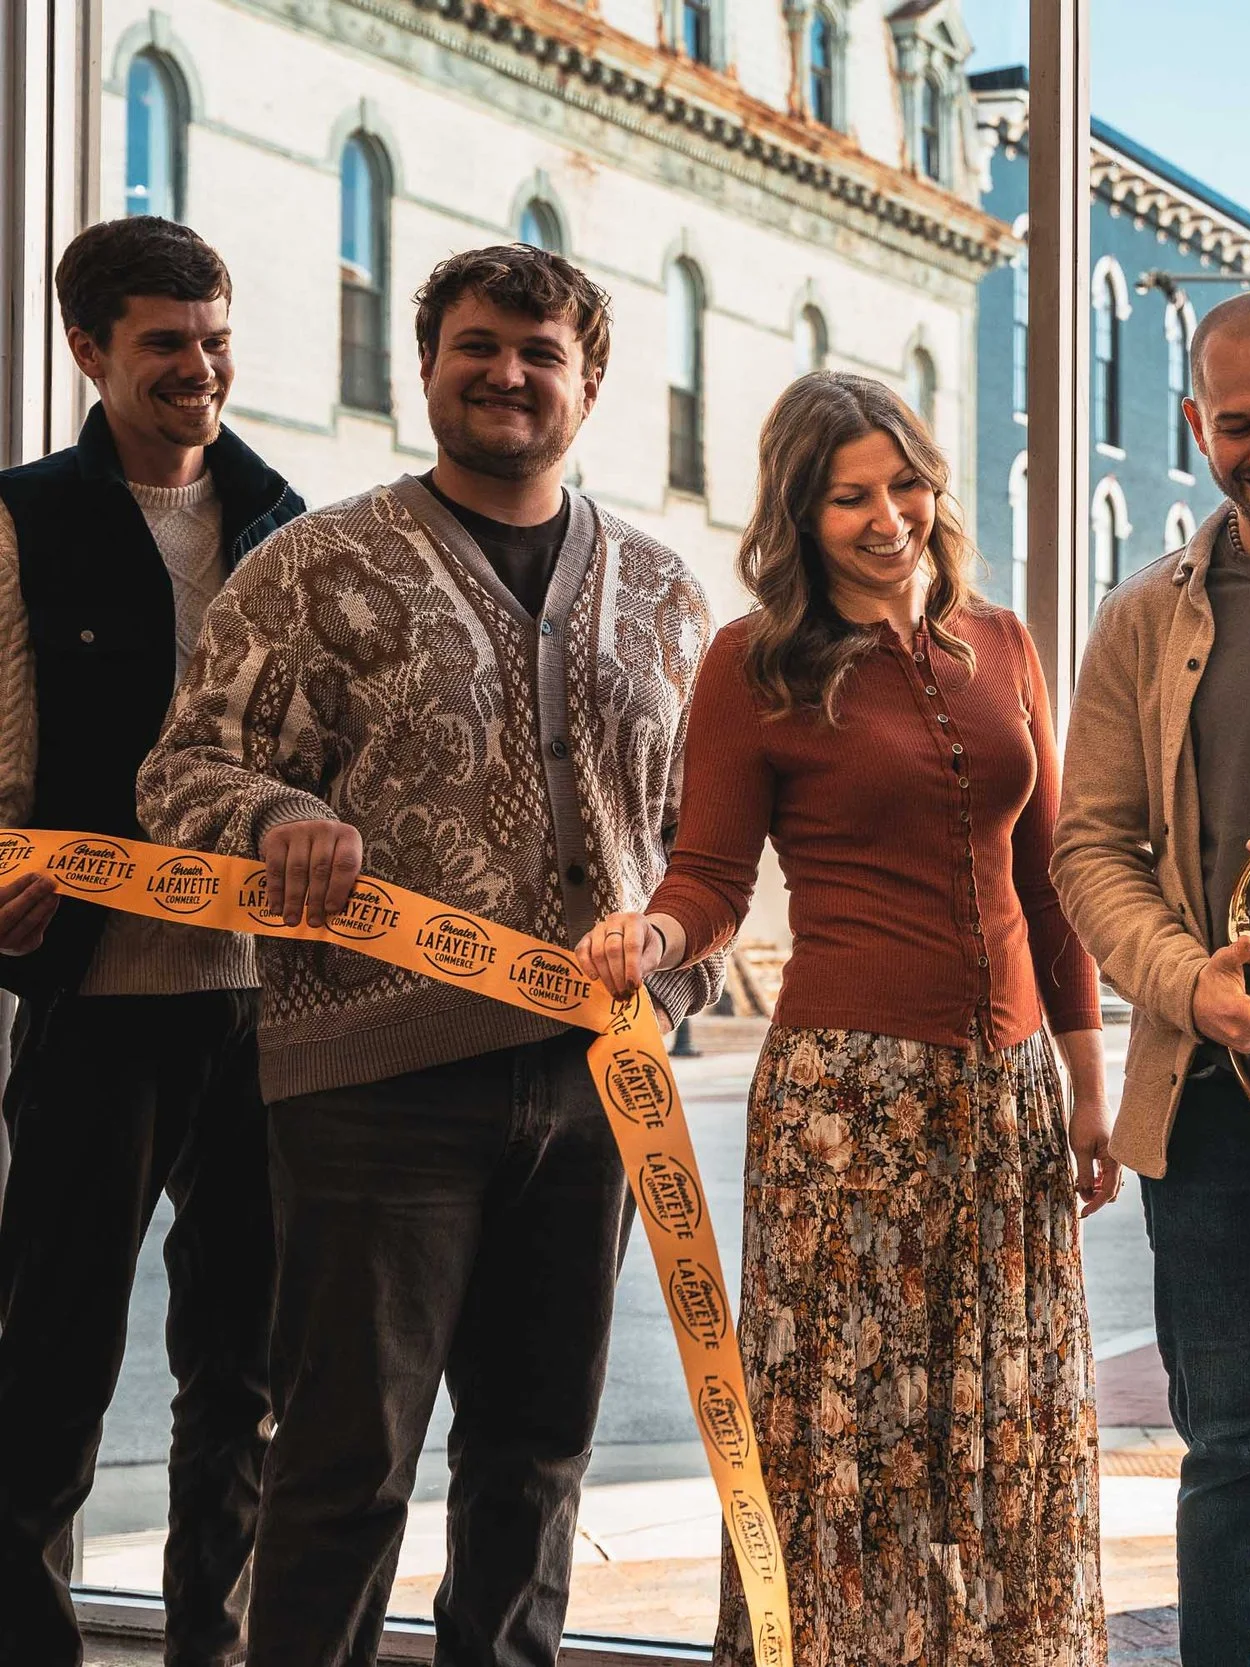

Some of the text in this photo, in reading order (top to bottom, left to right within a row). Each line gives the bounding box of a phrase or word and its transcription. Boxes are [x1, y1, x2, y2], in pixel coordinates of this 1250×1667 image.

[73, 844, 116, 859] Greater
[46, 854, 136, 879] LAFAYETTE
[65, 872, 110, 886] COMMERCE
[171, 862, 203, 876] Greater
[147, 876, 220, 894] LAFAYETTE
[165, 895, 200, 904] COMMERCE
[331, 917, 374, 933] COMMERCE
[342, 901, 401, 928] AYETTE
[439, 919, 477, 940] Greater
[415, 929, 497, 963] LAFAYETTE
[434, 952, 474, 969] COMMERCE
[531, 955, 570, 976] Greater
[509, 964, 591, 998] LAFAYETTE
[528, 987, 568, 1004] COMMERCE
[611, 1073, 637, 1111] COMMERCE
[612, 1048, 664, 1130] LAFAYETTE
[641, 1063, 665, 1104] Greater
[645, 1177, 669, 1219] COMMERCE
[646, 1152, 694, 1240] LAFAYETTE
[676, 1258, 720, 1350] LAFAYETTE
[704, 1375, 744, 1470] LAFAYETTE
[732, 1489, 774, 1584] LAFAYETTE
[764, 1611, 778, 1665] LAFAY
